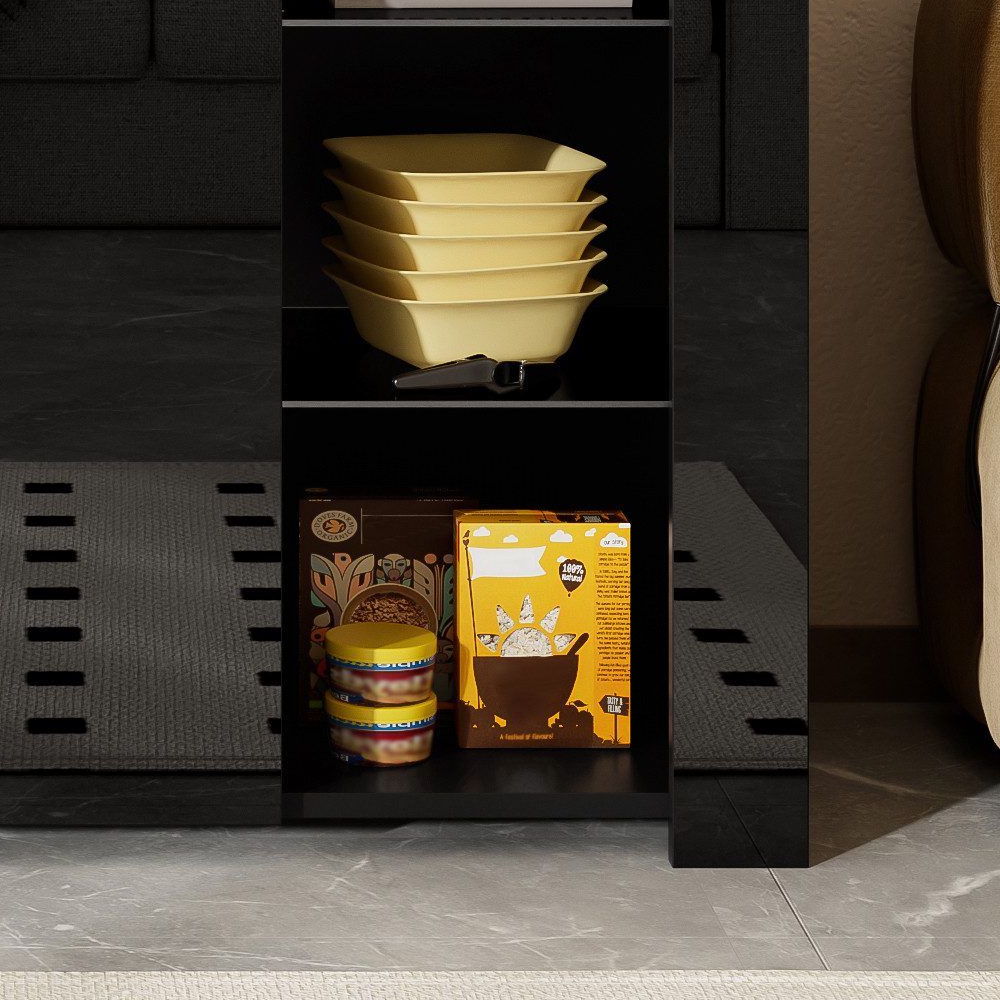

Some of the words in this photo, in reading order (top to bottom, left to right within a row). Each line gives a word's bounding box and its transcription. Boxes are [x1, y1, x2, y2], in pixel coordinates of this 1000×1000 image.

[313, 512, 336, 528] DOVES
[337, 512, 355, 528] FARM
[316, 529, 354, 541] ORGANIC
[562, 563, 584, 575] 100%
[561, 572, 583, 583] Natural
